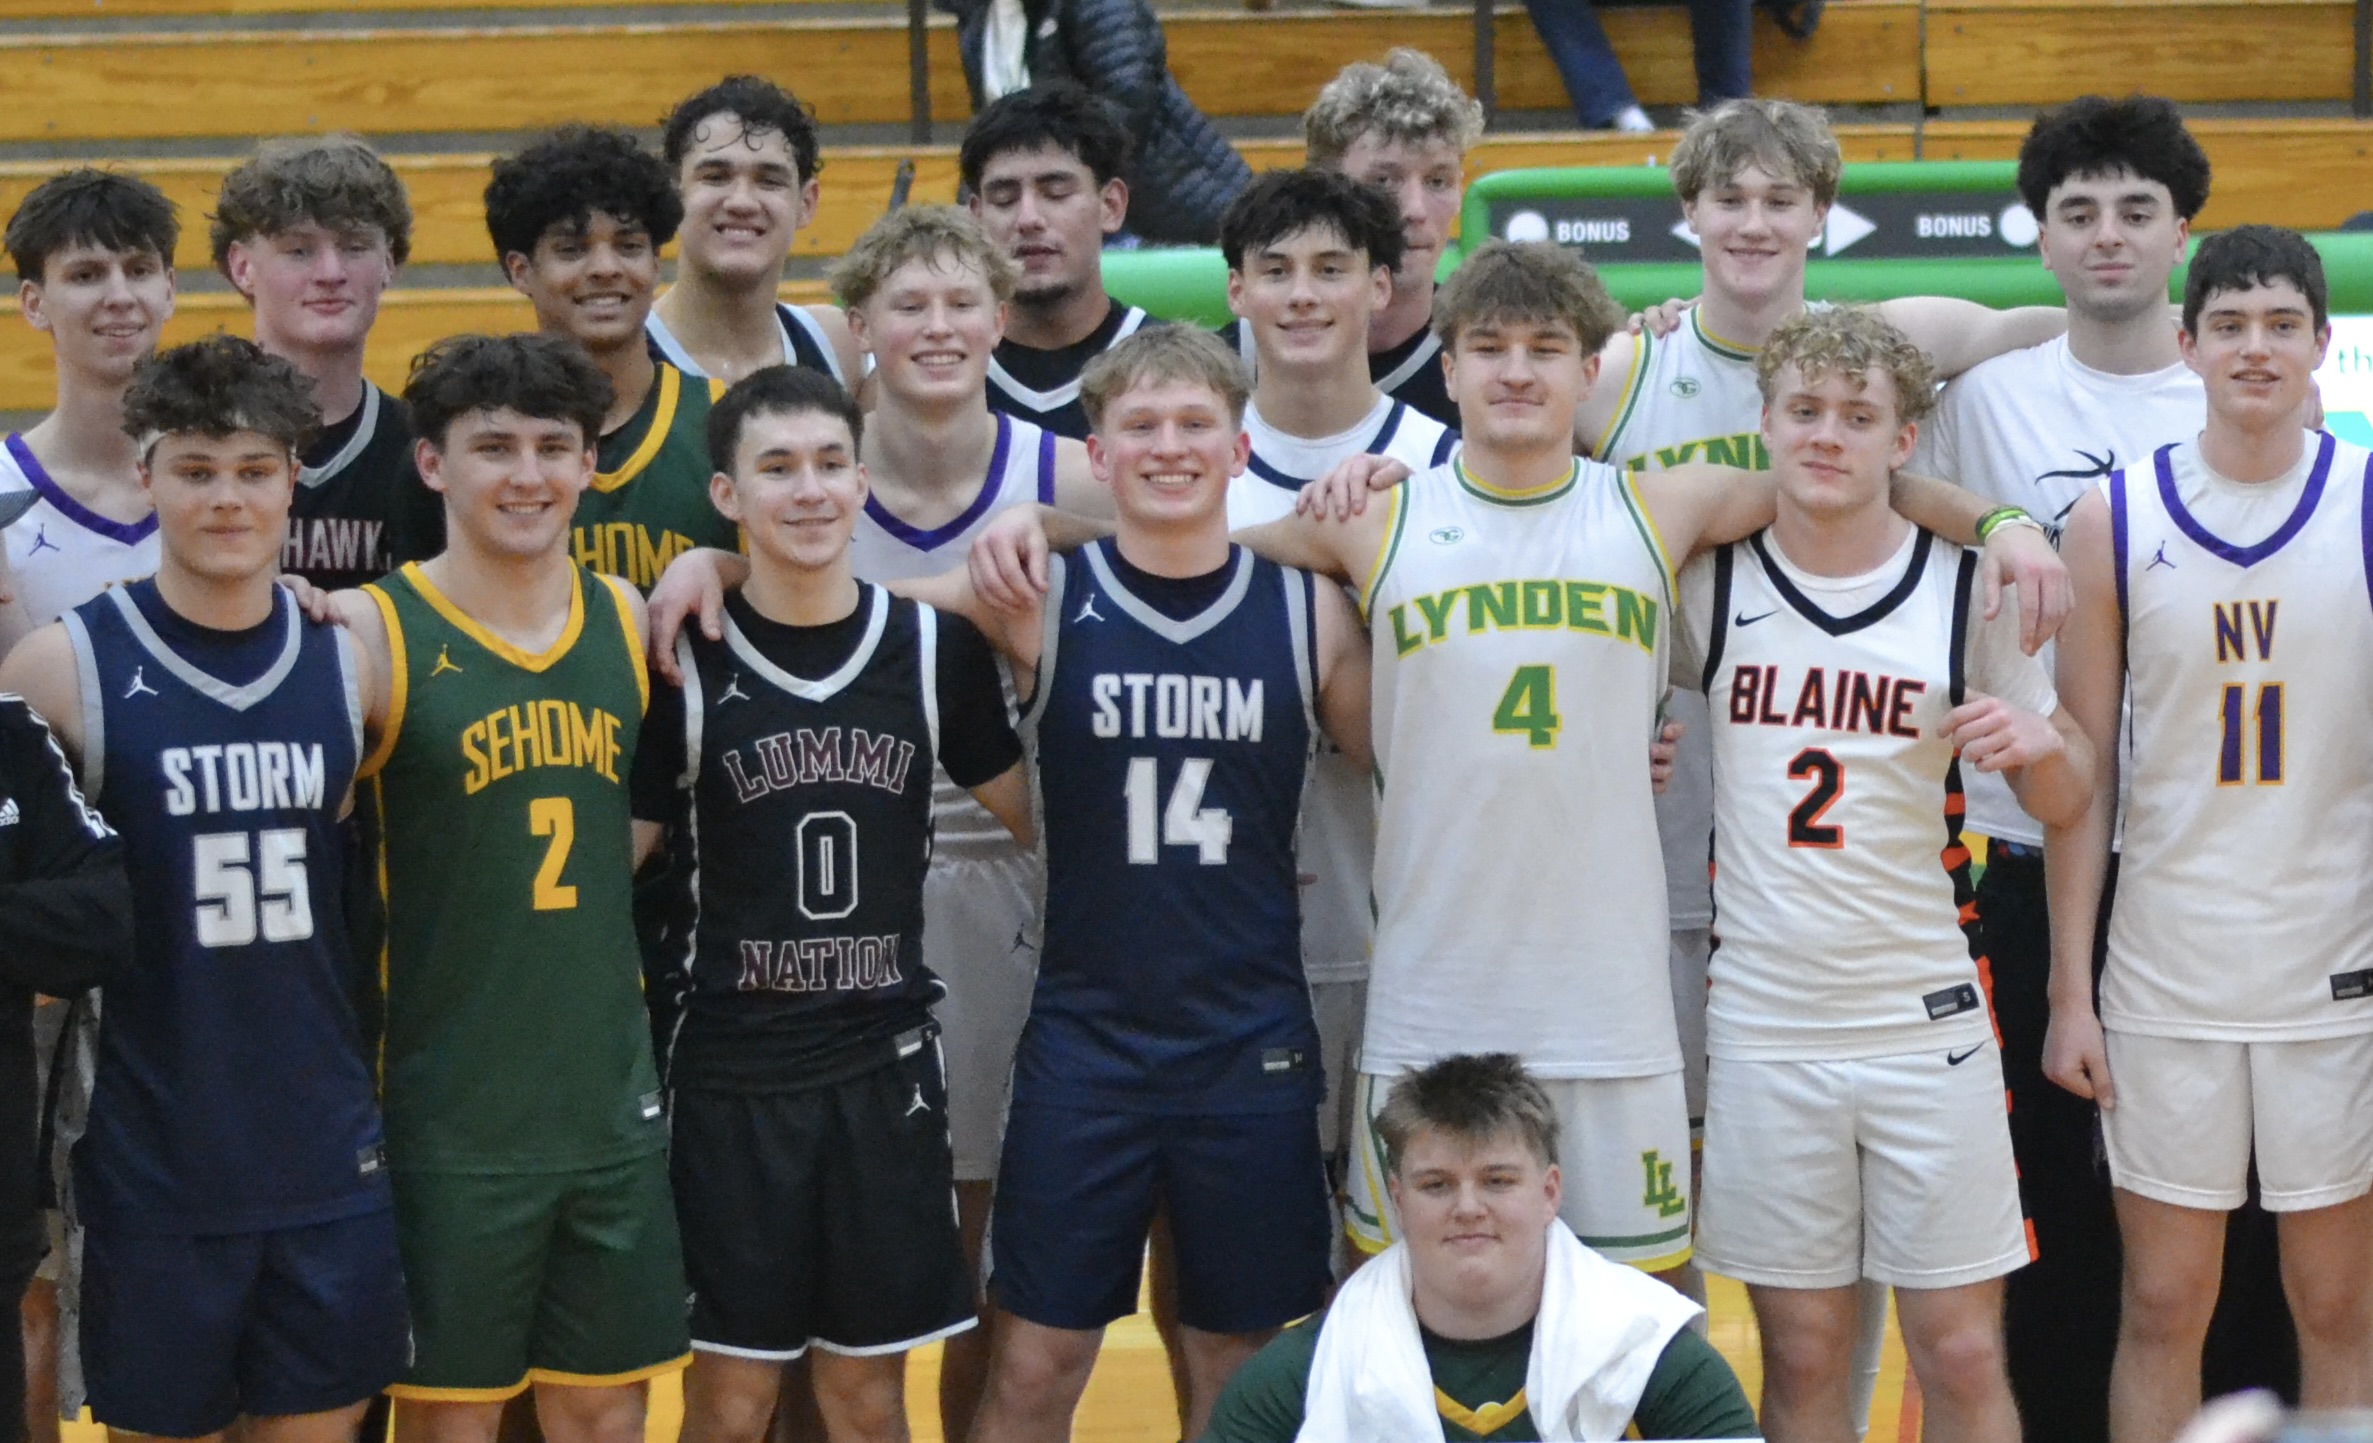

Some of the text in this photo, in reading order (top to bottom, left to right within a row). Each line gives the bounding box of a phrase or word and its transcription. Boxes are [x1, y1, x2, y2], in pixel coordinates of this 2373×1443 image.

[1557, 220, 1630, 242] BONUS
[1918, 215, 1992, 237] BONUS
[282, 518, 392, 573] HAWK
[1389, 579, 1658, 659] LYNDEN
[2213, 598, 2280, 665] NV
[1092, 673, 1264, 742] STORM
[1492, 662, 1562, 749] 4
[1729, 665, 1927, 740] BLAINE
[2216, 682, 2285, 787] 11
[162, 741, 325, 816] STORM
[461, 698, 622, 795] SEHOME
[722, 726, 916, 804] LUMMI
[1123, 757, 1233, 865] 14
[1787, 747, 1845, 849] 2
[193, 828, 314, 948] 55
[529, 796, 578, 911] 2
[796, 811, 858, 920] 0
[738, 934, 903, 992] NATION
